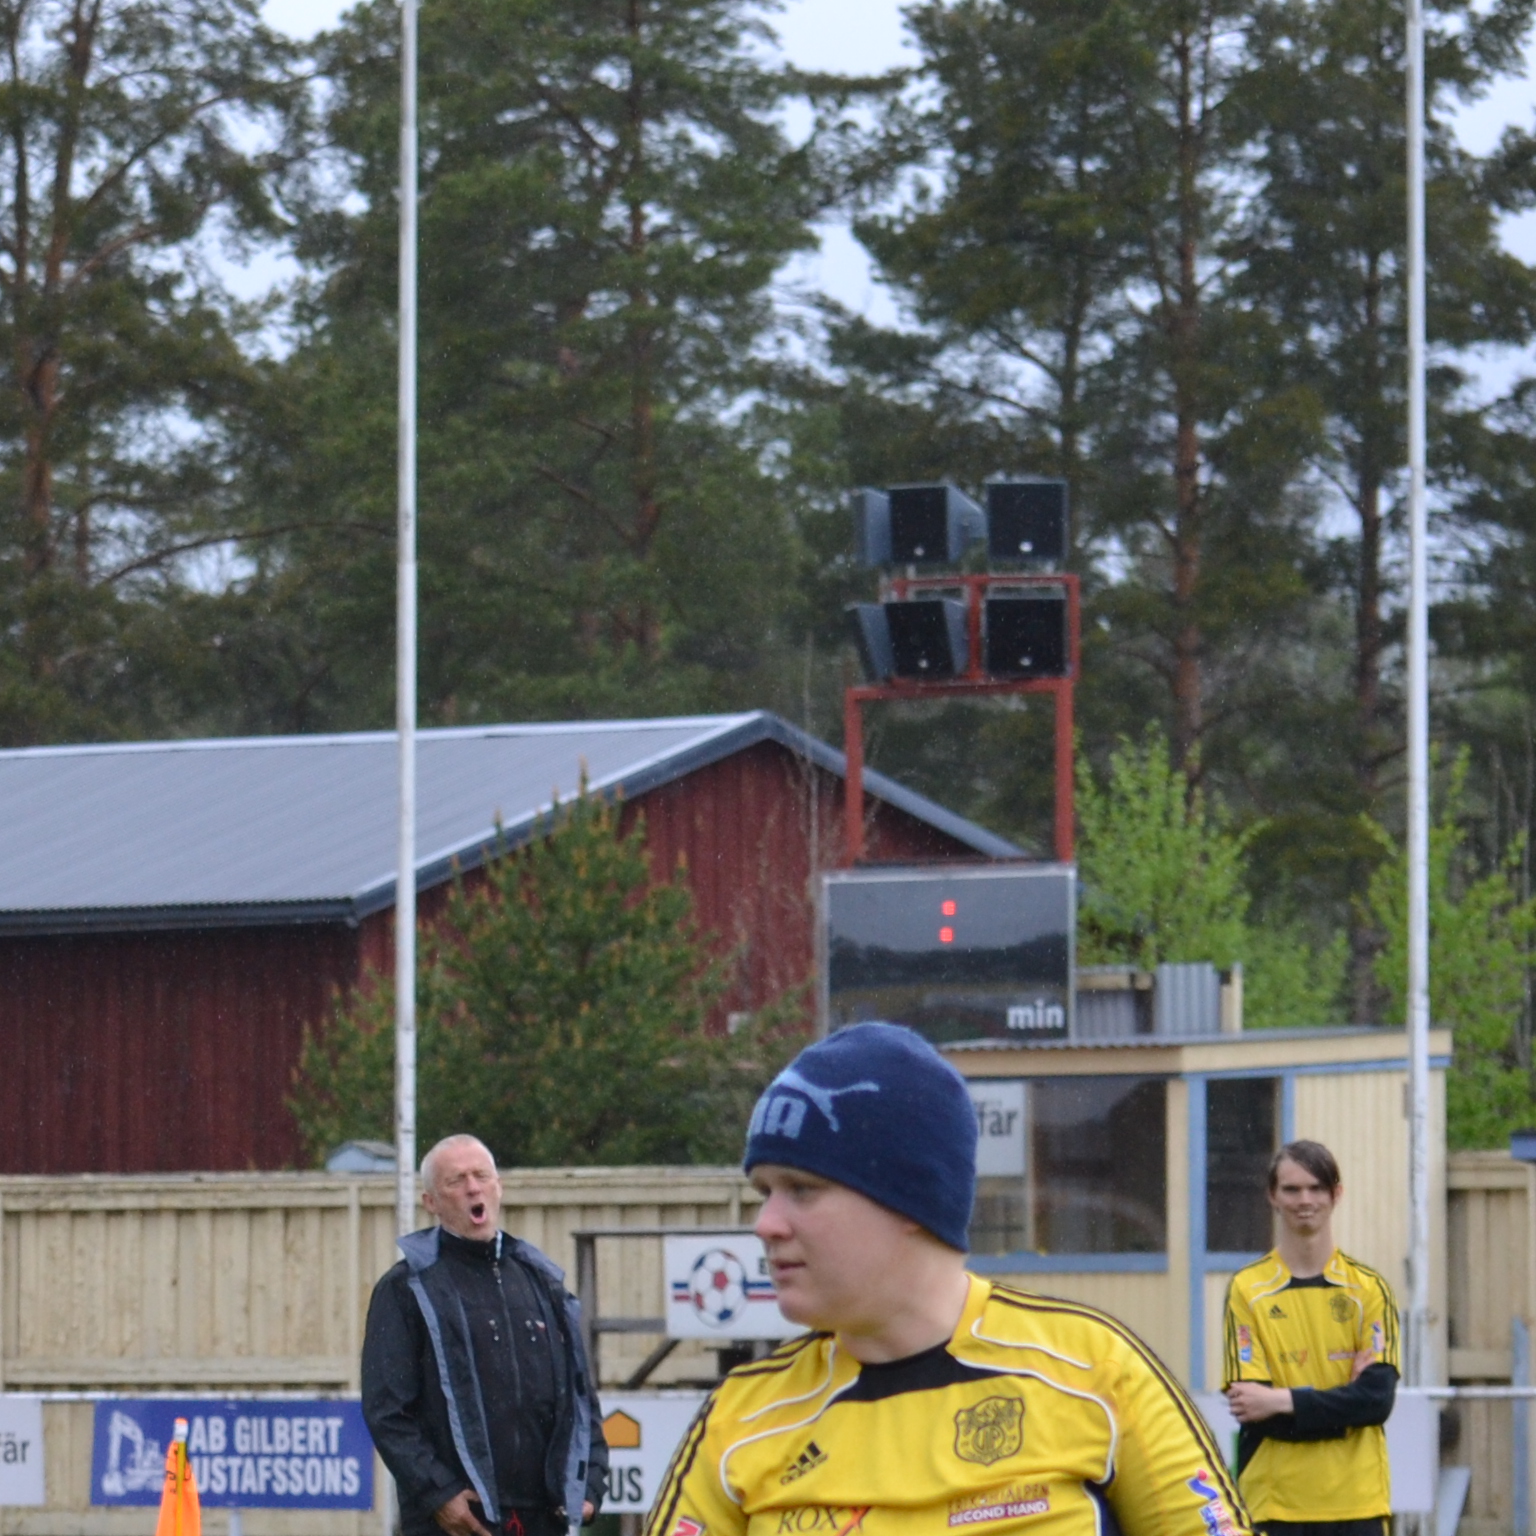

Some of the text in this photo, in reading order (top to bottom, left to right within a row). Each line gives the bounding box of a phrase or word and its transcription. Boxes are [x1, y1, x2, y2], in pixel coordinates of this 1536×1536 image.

[1007, 998, 1065, 1029] min
[188, 1416, 343, 1455] AB GILBERT
[192, 1456, 361, 1496] USTAFSSONS
[950, 1501, 1048, 1525] SECOND HAND
